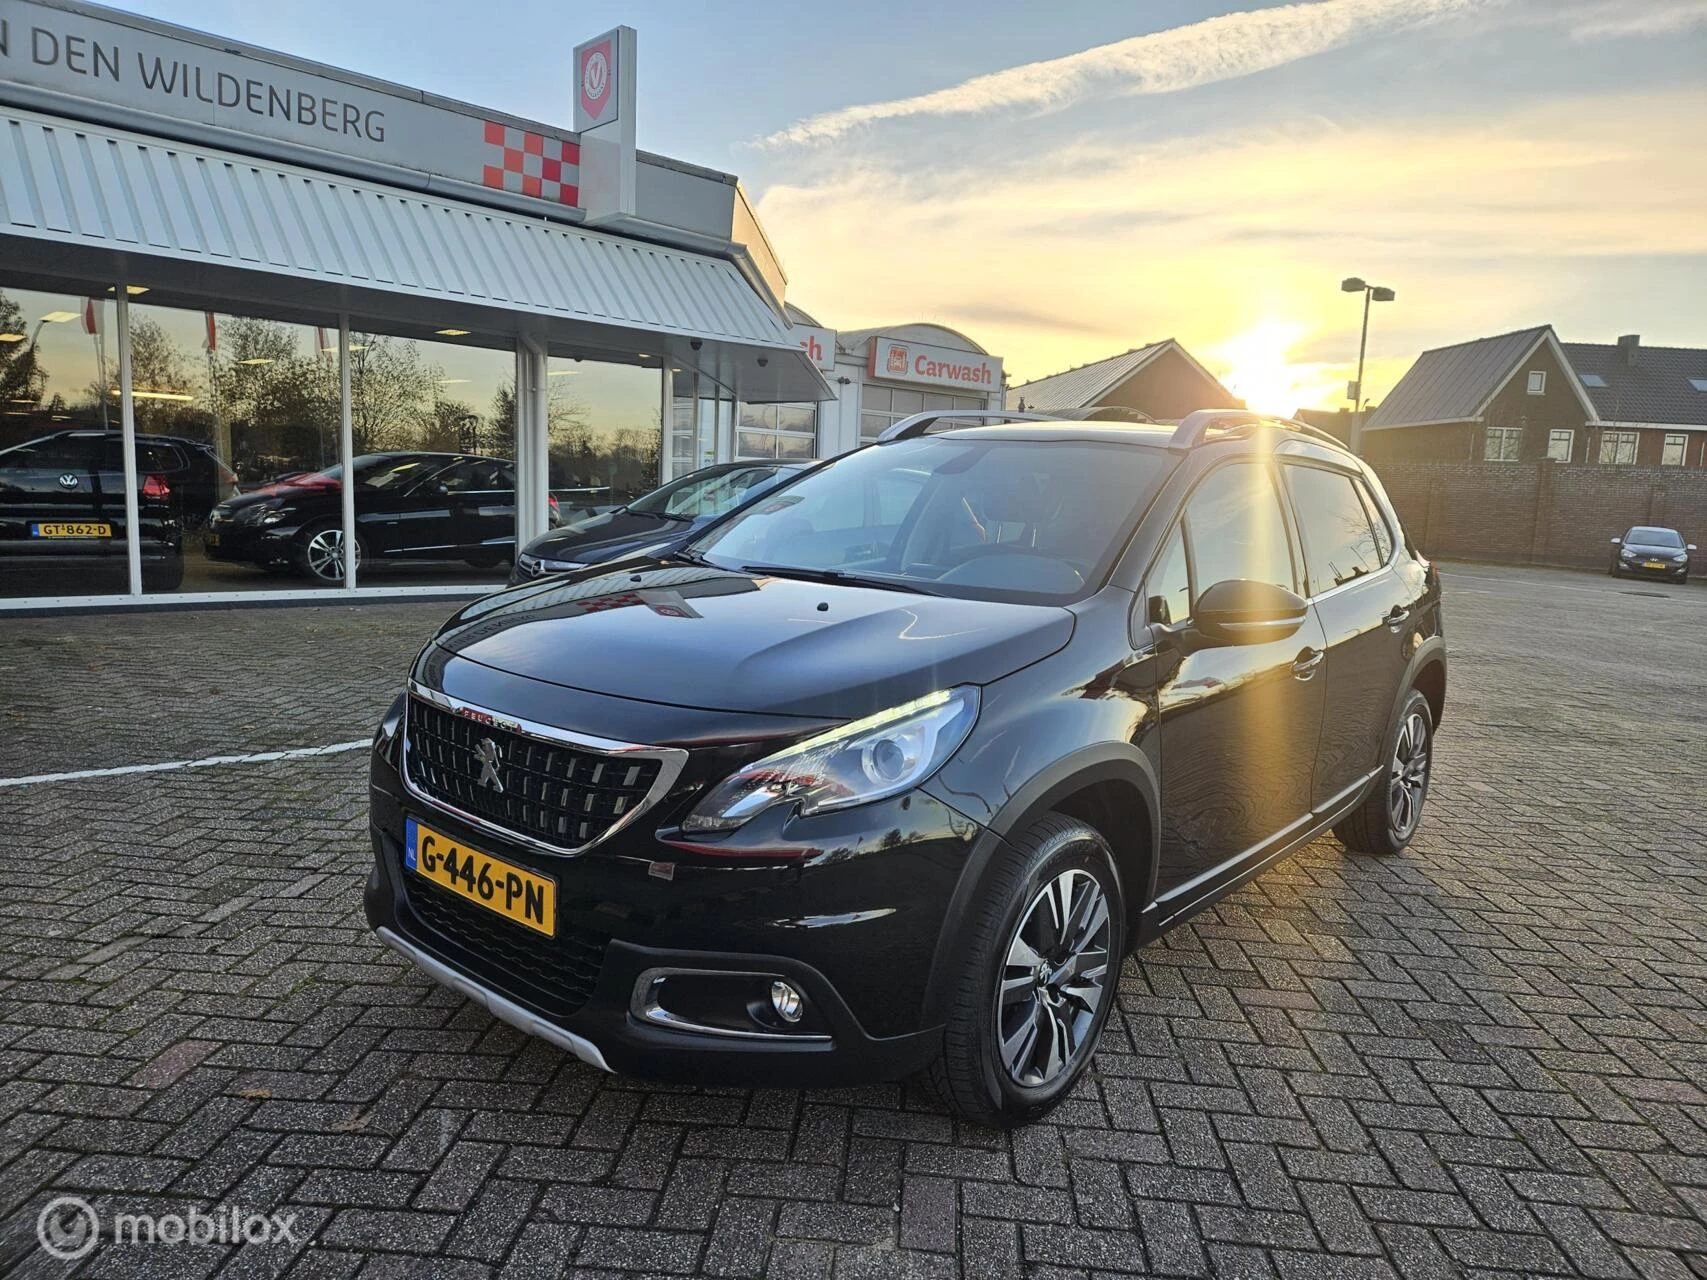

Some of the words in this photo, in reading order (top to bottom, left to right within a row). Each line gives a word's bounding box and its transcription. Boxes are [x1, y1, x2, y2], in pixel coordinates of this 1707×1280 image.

[31, 26, 120, 82] DEN
[137, 52, 385, 142] WILDENBERG
[914, 354, 992, 385] Carwash
[408, 847, 416, 862] NL
[421, 835, 545, 925] G-446-PN
